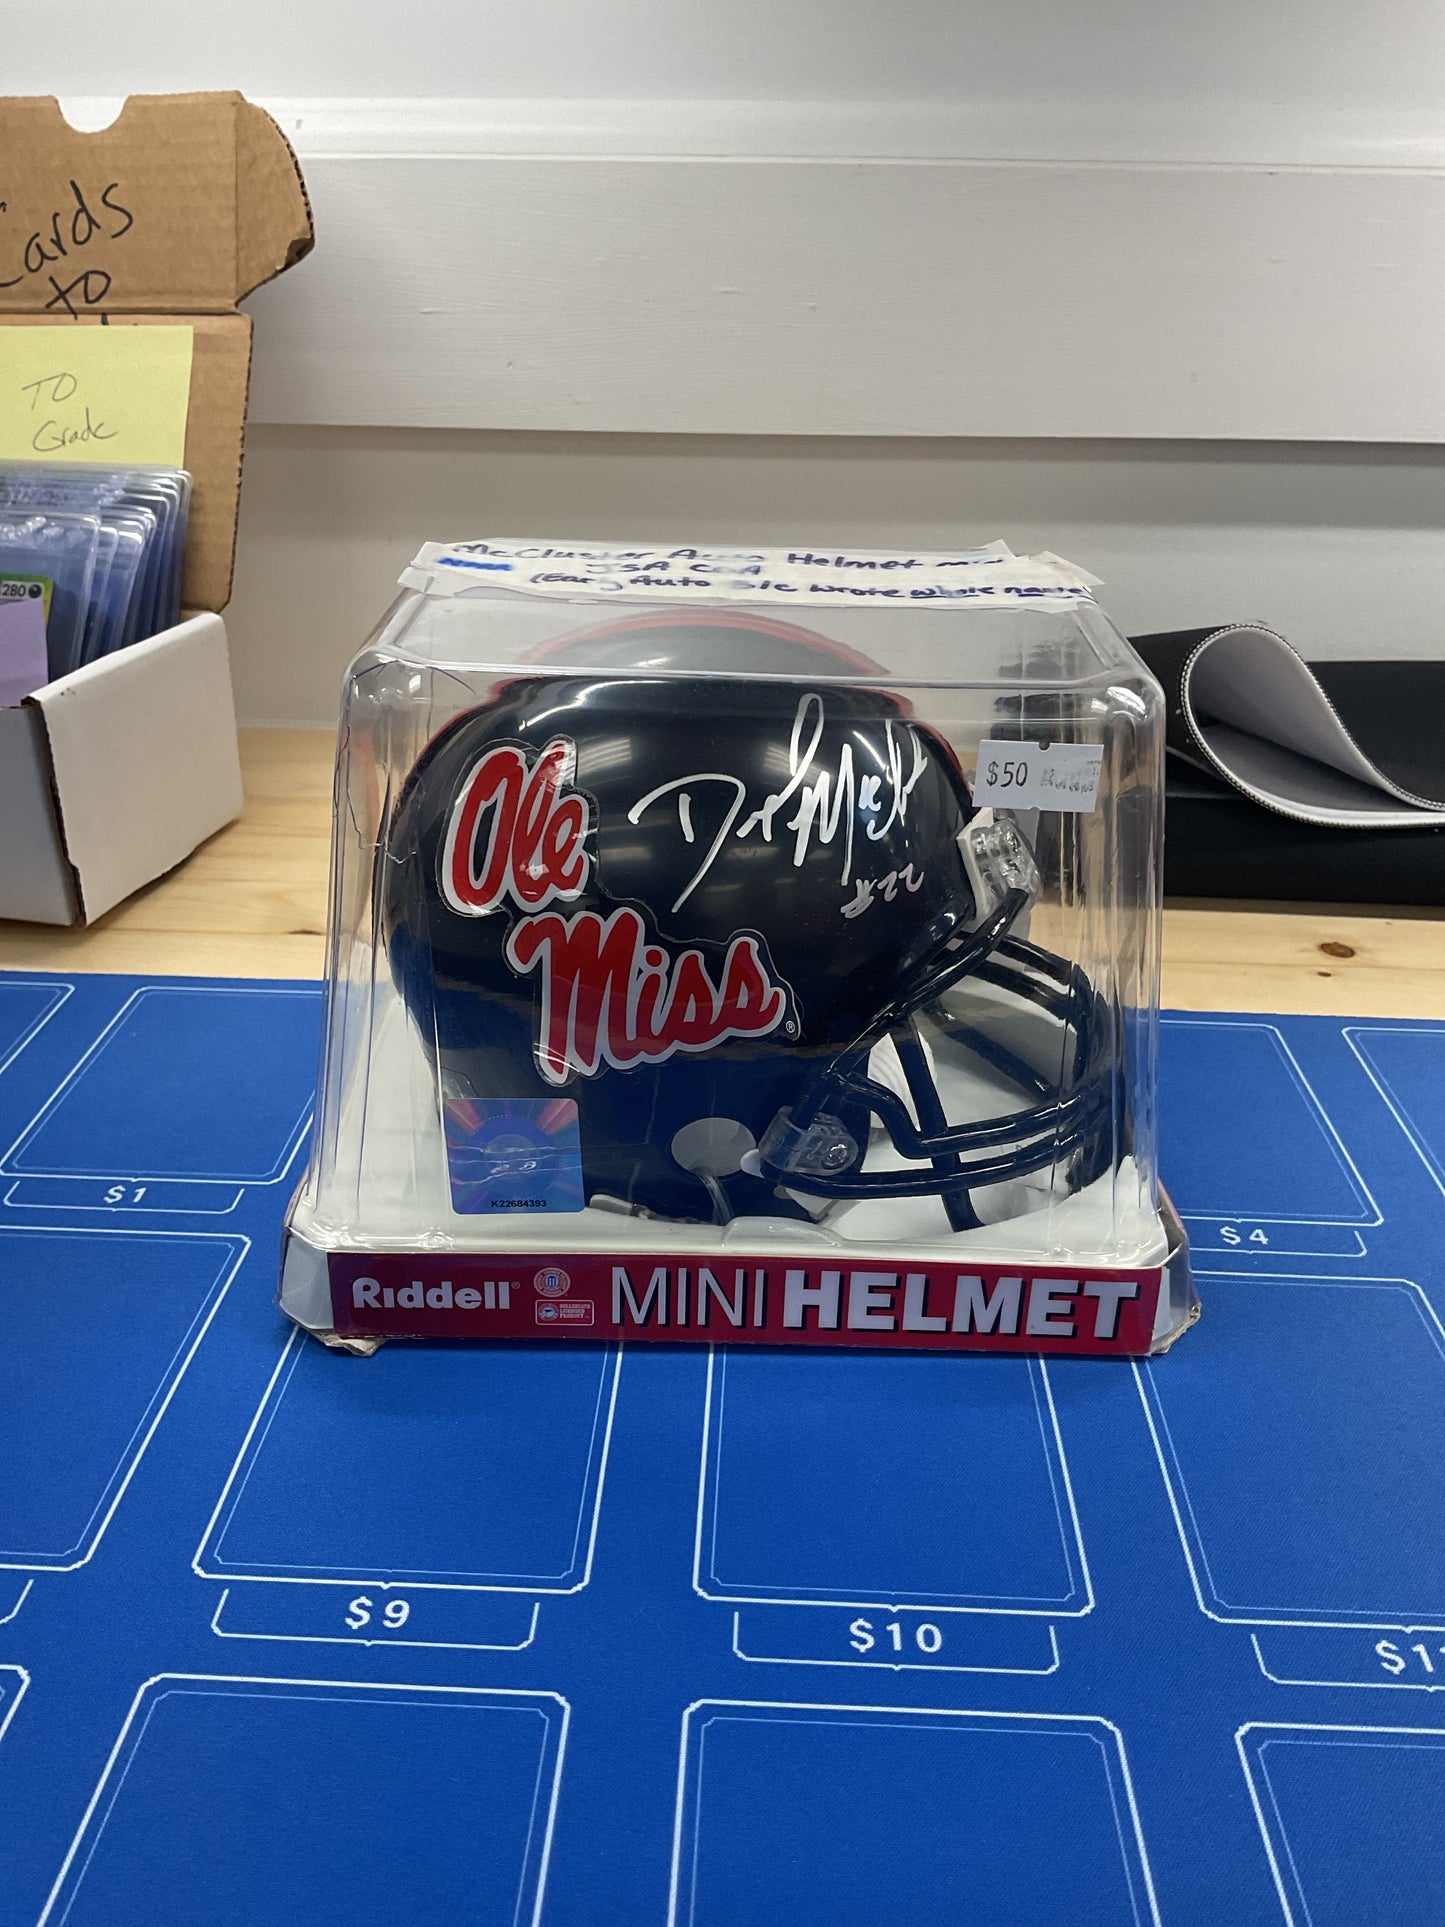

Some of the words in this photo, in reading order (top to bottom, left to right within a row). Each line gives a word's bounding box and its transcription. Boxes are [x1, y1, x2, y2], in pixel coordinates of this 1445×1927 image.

[32, 407, 119, 453] Grade
[787, 552, 924, 570] Helmet
[630, 573, 712, 588] Auto
[809, 582, 905, 598] wrote
[985, 760, 1029, 788] $50
[443, 740, 590, 915] Ole
[506, 906, 786, 1083] Miss
[103, 1184, 147, 1203] $1
[1219, 1226, 1269, 1246] $4
[351, 1276, 511, 1311] Riddell
[610, 1266, 765, 1328] MINI
[782, 1269, 1139, 1339] HELMET
[344, 1596, 411, 1630] $9
[848, 1617, 944, 1654] $10
[1374, 1639, 1445, 1676] $1
